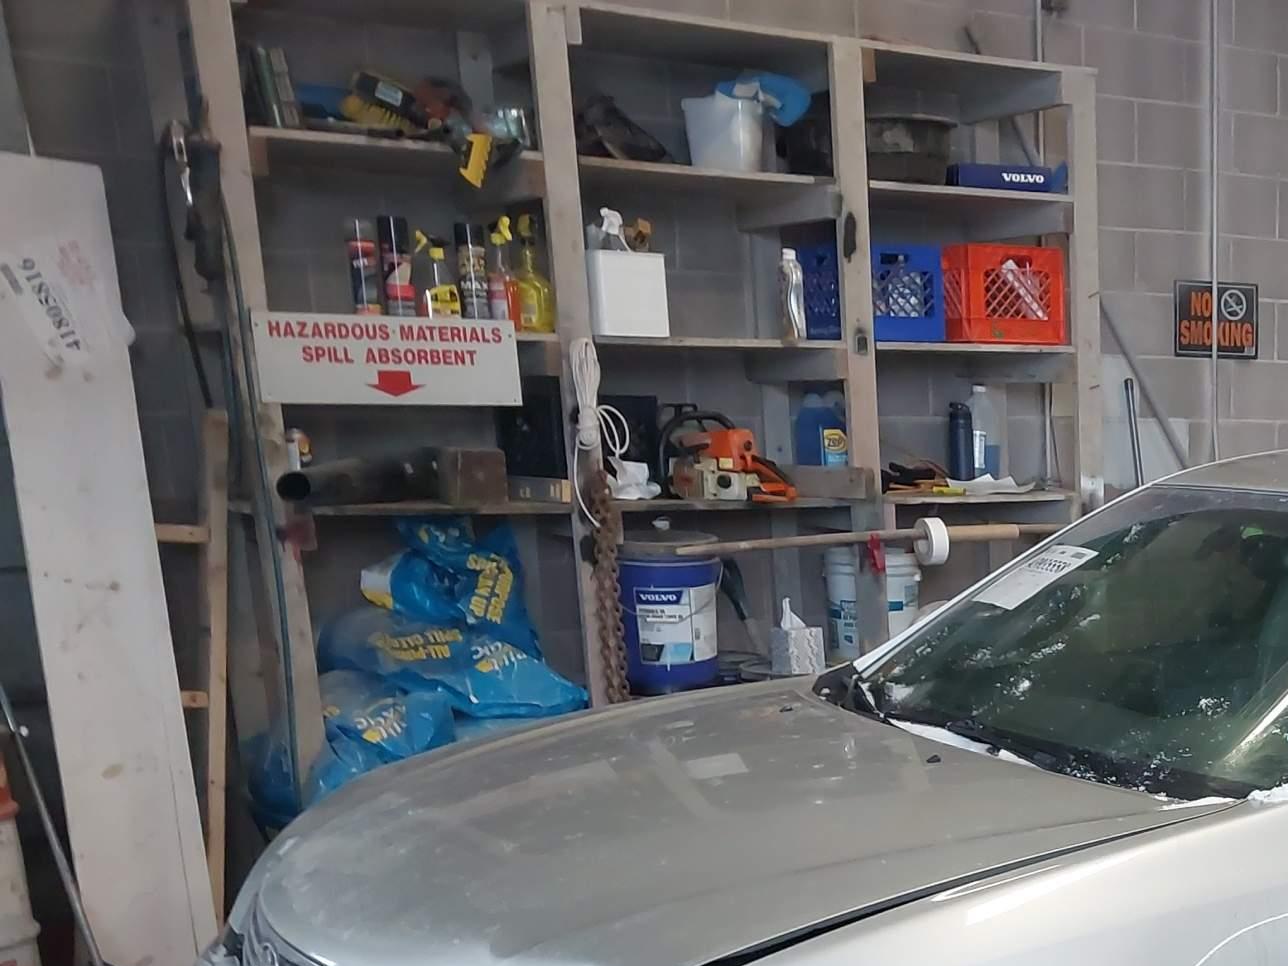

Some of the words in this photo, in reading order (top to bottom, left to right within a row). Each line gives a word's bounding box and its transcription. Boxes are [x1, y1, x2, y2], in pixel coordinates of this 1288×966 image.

[1001, 172, 1045, 184] VOLVO
[1191, 291, 1212, 318] NO
[267, 320, 390, 340] HAZARDOUS
[400, 325, 502, 344] MATERIALS
[1180, 319, 1253, 347] SMOKING
[302, 346, 354, 364] SPILL
[365, 348, 477, 366] ABSORBENT
[639, 593, 678, 602] VOLVO
